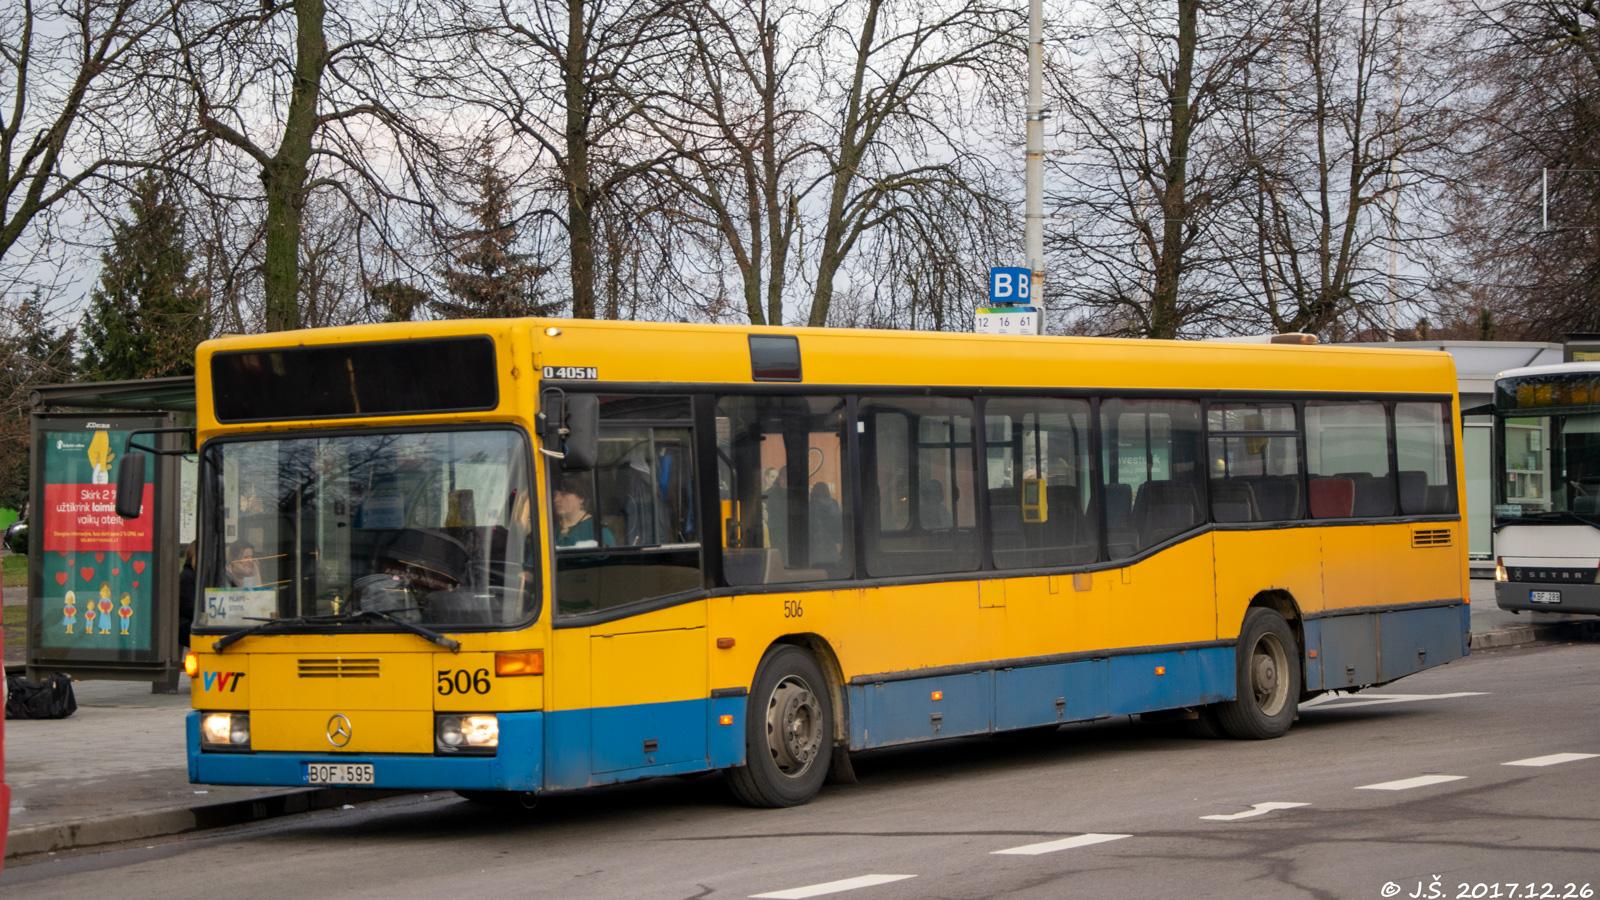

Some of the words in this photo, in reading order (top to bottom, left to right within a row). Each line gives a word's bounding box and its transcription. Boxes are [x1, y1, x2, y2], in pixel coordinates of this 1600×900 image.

[994, 273, 1013, 298] B
[1018, 273, 1029, 298] B
[978, 317, 989, 327] 12
[999, 317, 1010, 327] 16
[1020, 316, 1030, 326] 61
[81, 489, 101, 500] Skirk
[102, 489, 110, 500] 2
[56, 502, 91, 512] užtikrink
[1528, 571, 1582, 579] SETRA
[208, 597, 226, 619] 54
[784, 600, 803, 618] 506
[203, 671, 246, 693] VVT
[437, 668, 492, 696] 506
[346, 766, 372, 782] 595
